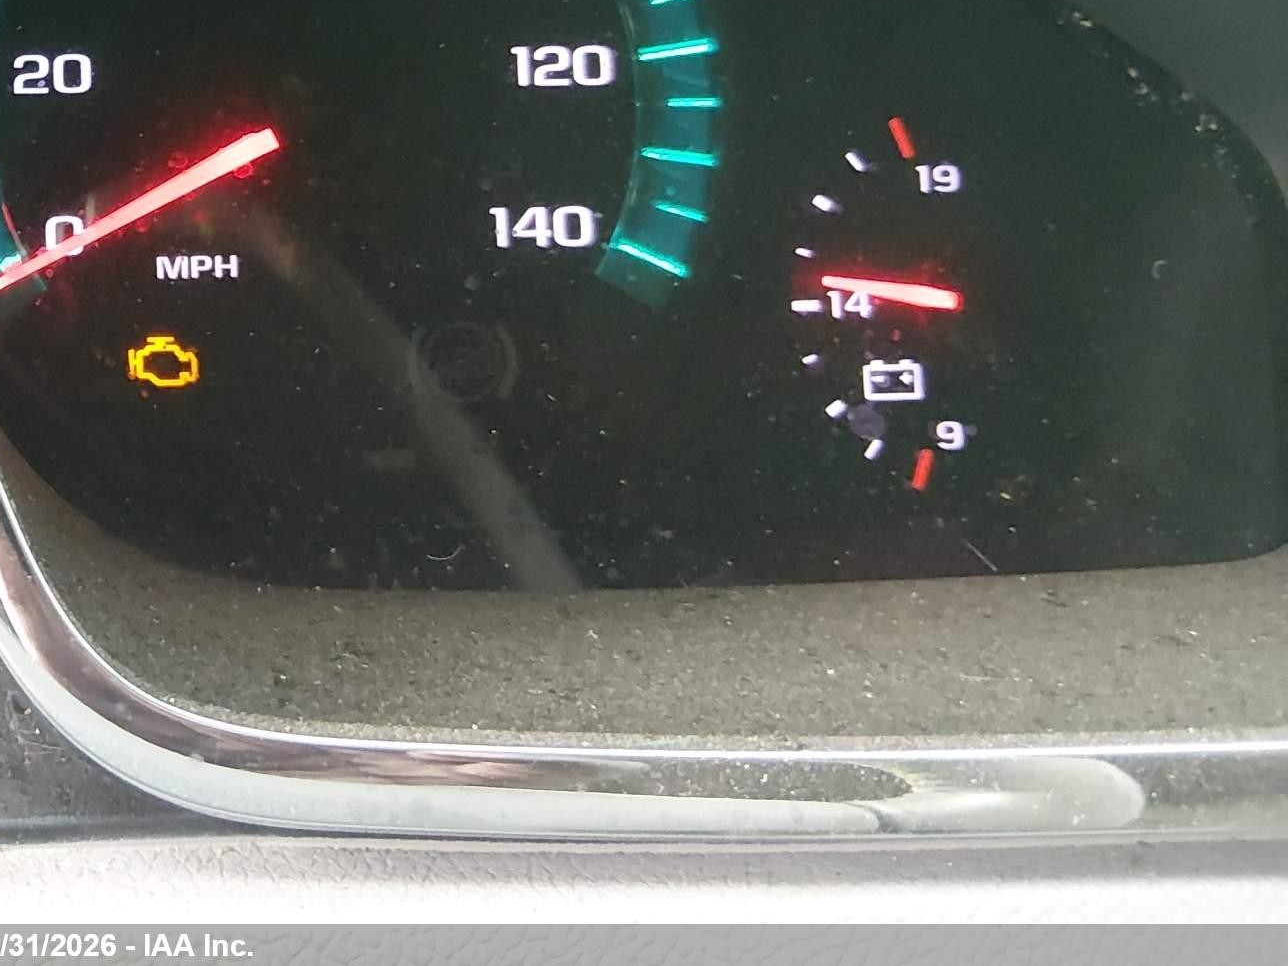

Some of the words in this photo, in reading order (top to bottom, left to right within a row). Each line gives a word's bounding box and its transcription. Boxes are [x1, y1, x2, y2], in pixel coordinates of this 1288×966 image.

[12, 54, 91, 94] 20
[511, 45, 615, 87] 120
[915, 164, 961, 194] 19
[45, 214, 85, 256] 0
[489, 205, 595, 248] 140
[156, 254, 238, 279] MPH
[827, 291, 873, 319] 14
[935, 421, 967, 451] 9
